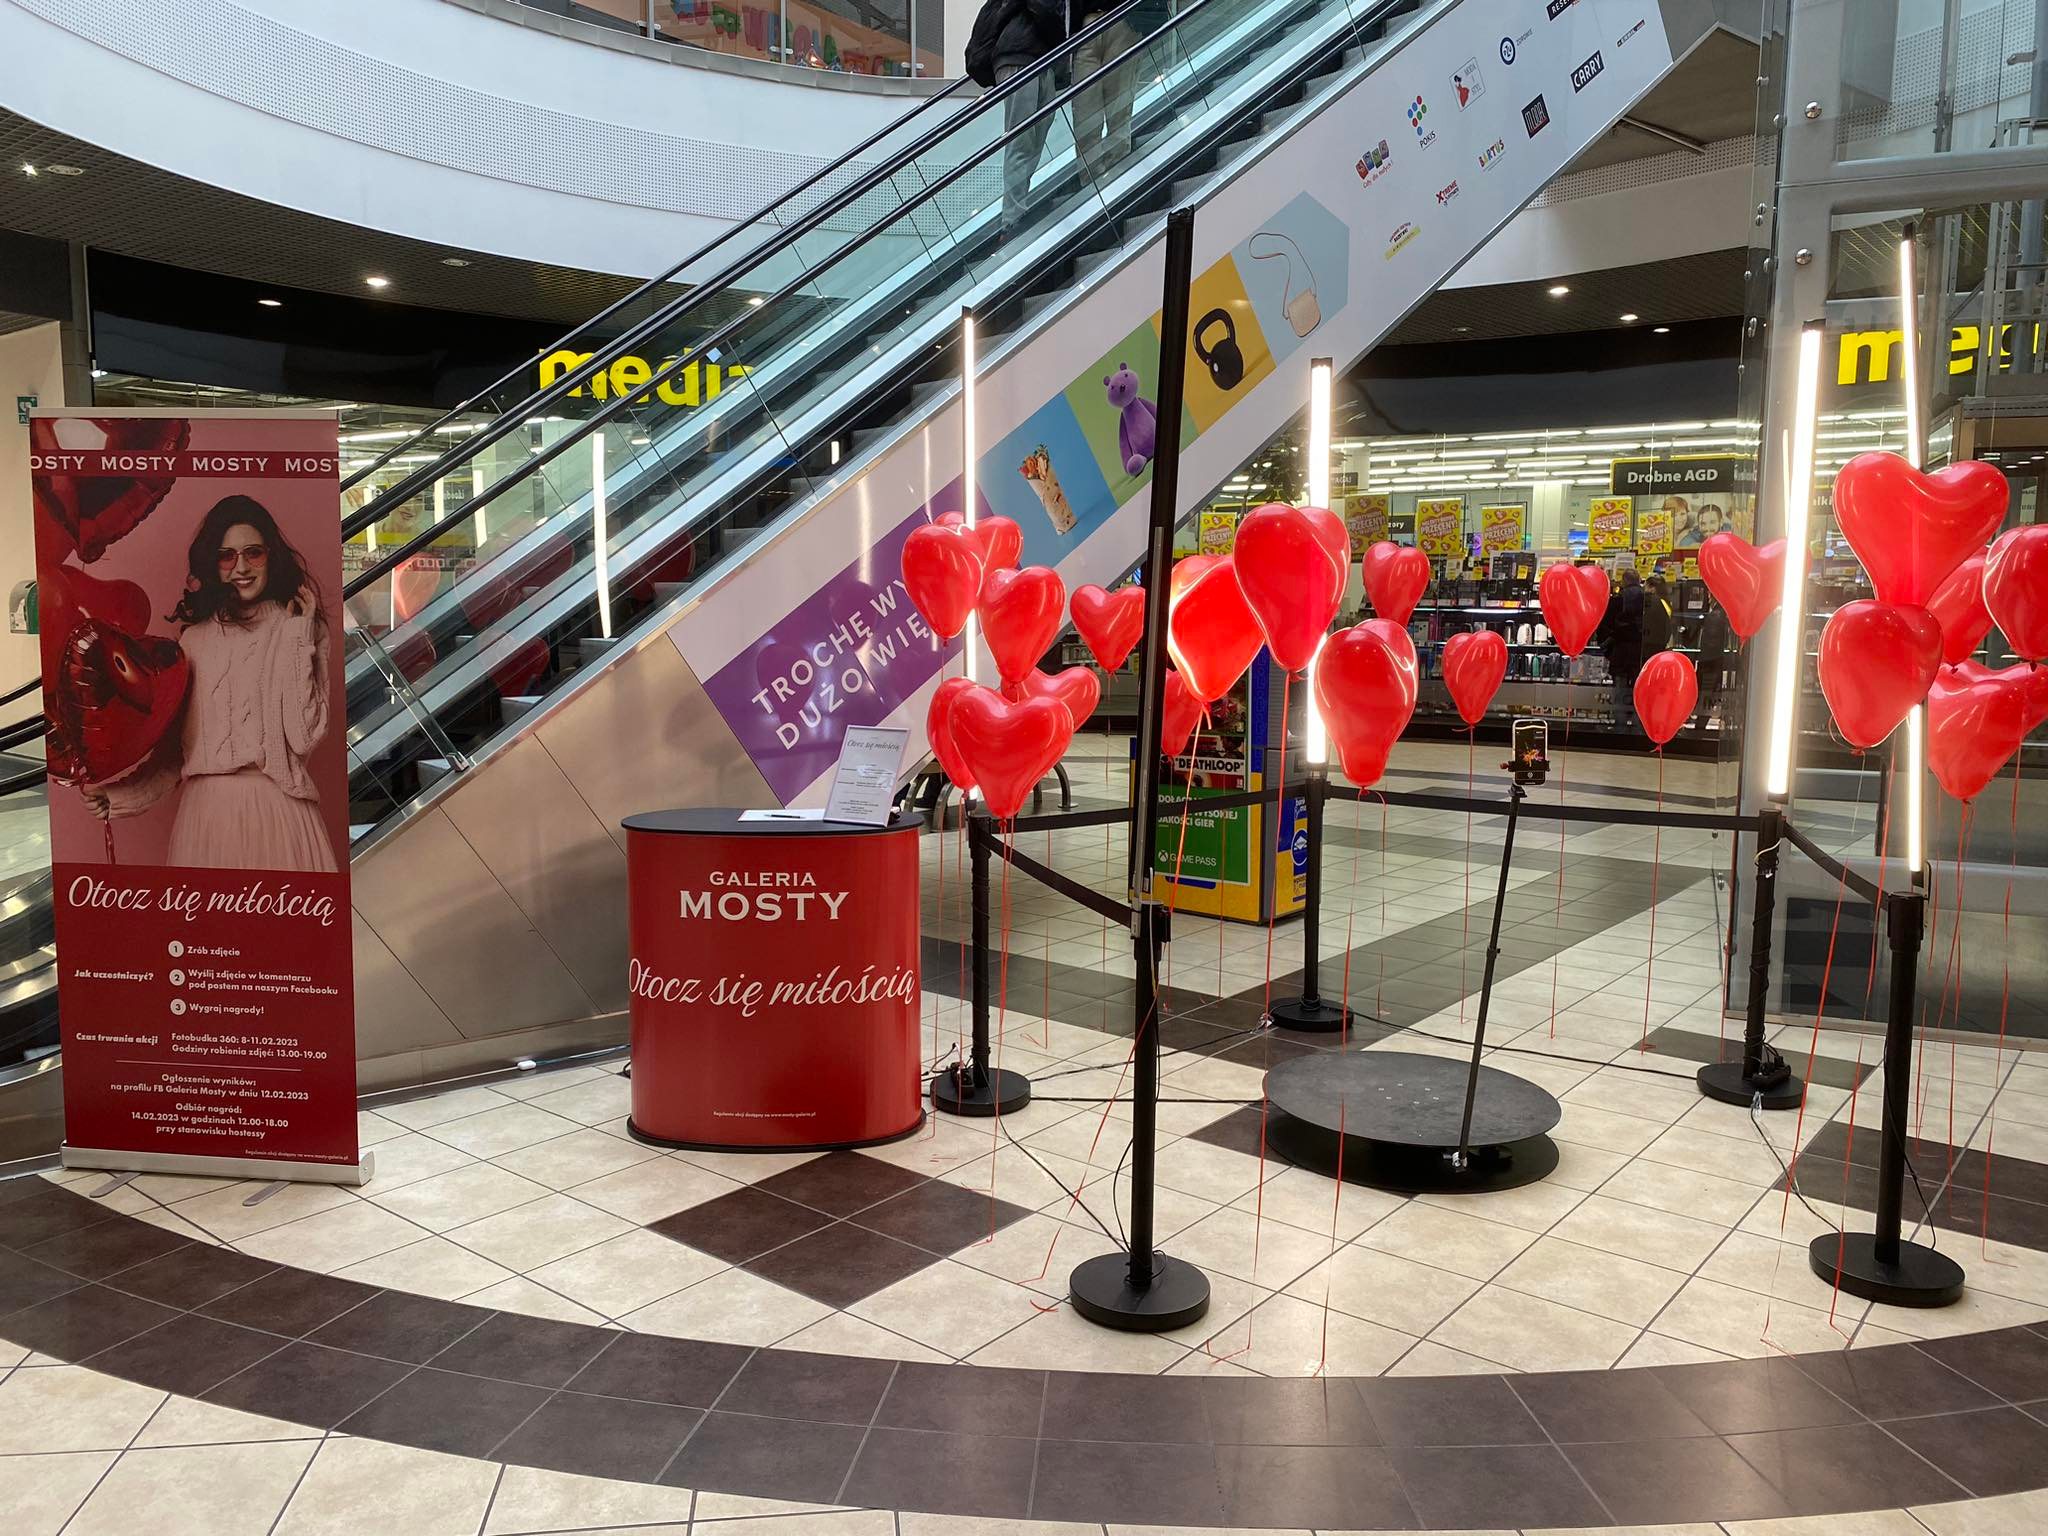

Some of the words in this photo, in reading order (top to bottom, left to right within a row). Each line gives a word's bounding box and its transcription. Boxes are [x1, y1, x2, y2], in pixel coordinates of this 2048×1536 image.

[1573, 54, 1600, 87] CARRY
[1420, 130, 1436, 149] POKIS
[539, 348, 753, 407] medi
[101, 457, 177, 471] MOSTY
[192, 458, 269, 472] MOSTY
[285, 458, 338, 472] MOS
[1627, 471, 1681, 483] Drobne
[1684, 469, 1718, 481] AGD
[752, 610, 873, 714] TROCHĘ
[776, 668, 862, 750] DUŻO
[1194, 818, 1215, 828] GIER
[1170, 853, 1194, 864] GME
[1195, 855, 1216, 866] PASS
[709, 871, 817, 887] GALERIA
[68, 875, 153, 910] Otocz
[158, 884, 202, 922] się
[206, 880, 336, 927] miłością
[679, 890, 850, 921] MOSTY
[187, 946, 207, 956] Zrób
[210, 948, 241, 957] zdjęcie
[74, 969, 91, 978] Jak
[93, 971, 154, 981] uczestniczyć?
[188, 969, 214, 980] Wyślij
[216, 971, 246, 982] zdjęcie
[259, 974, 312, 983] komentarzu
[188, 981, 206, 992] pod
[207, 982, 239, 993] postem
[255, 985, 289, 994] naszym
[291, 985, 338, 996] Facebooku
[628, 958, 703, 1003] Otocz
[708, 973, 763, 1018] się
[768, 965, 916, 1006] miłością
[189, 1003, 222, 1015] Wygraj
[224, 1006, 264, 1016] nagrody!
[76, 1033, 96, 1042] Czas
[98, 1034, 133, 1043] trwania
[135, 1036, 158, 1045] akcji
[171, 1033, 218, 1044] Fotobudka
[219, 1035, 239, 1045] 360:
[241, 1036, 298, 1047] 8-11.02.2023
[172, 1044, 208, 1055] Godziny
[210, 1045, 247, 1056] robienia
[249, 1048, 274, 1059] zdjęć:
[276, 1049, 327, 1060] 13.00-19.00
[161, 1073, 210, 1085] Ogłoszenie
[213, 1076, 256, 1087] wyników:
[111, 1083, 121, 1091] na
[124, 1082, 151, 1094] profilu
[154, 1085, 164, 1093] FB
[165, 1085, 198, 1095] Galeria
[200, 1087, 226, 1098] Mosty
[239, 1088, 258, 1098] dniu
[260, 1090, 309, 1101] 12.02.2023
[175, 1103, 206, 1112] Odbiór
[208, 1104, 243, 1115] nagród:
[131, 1111, 179, 1122] 14.02.2023
[191, 1114, 236, 1126] godzinach
[238, 1117, 289, 1128] 12.00-18.00
[156, 1125, 176, 1134] przy
[178, 1125, 227, 1135] stanowisku
[228, 1127, 266, 1139] hostessy
